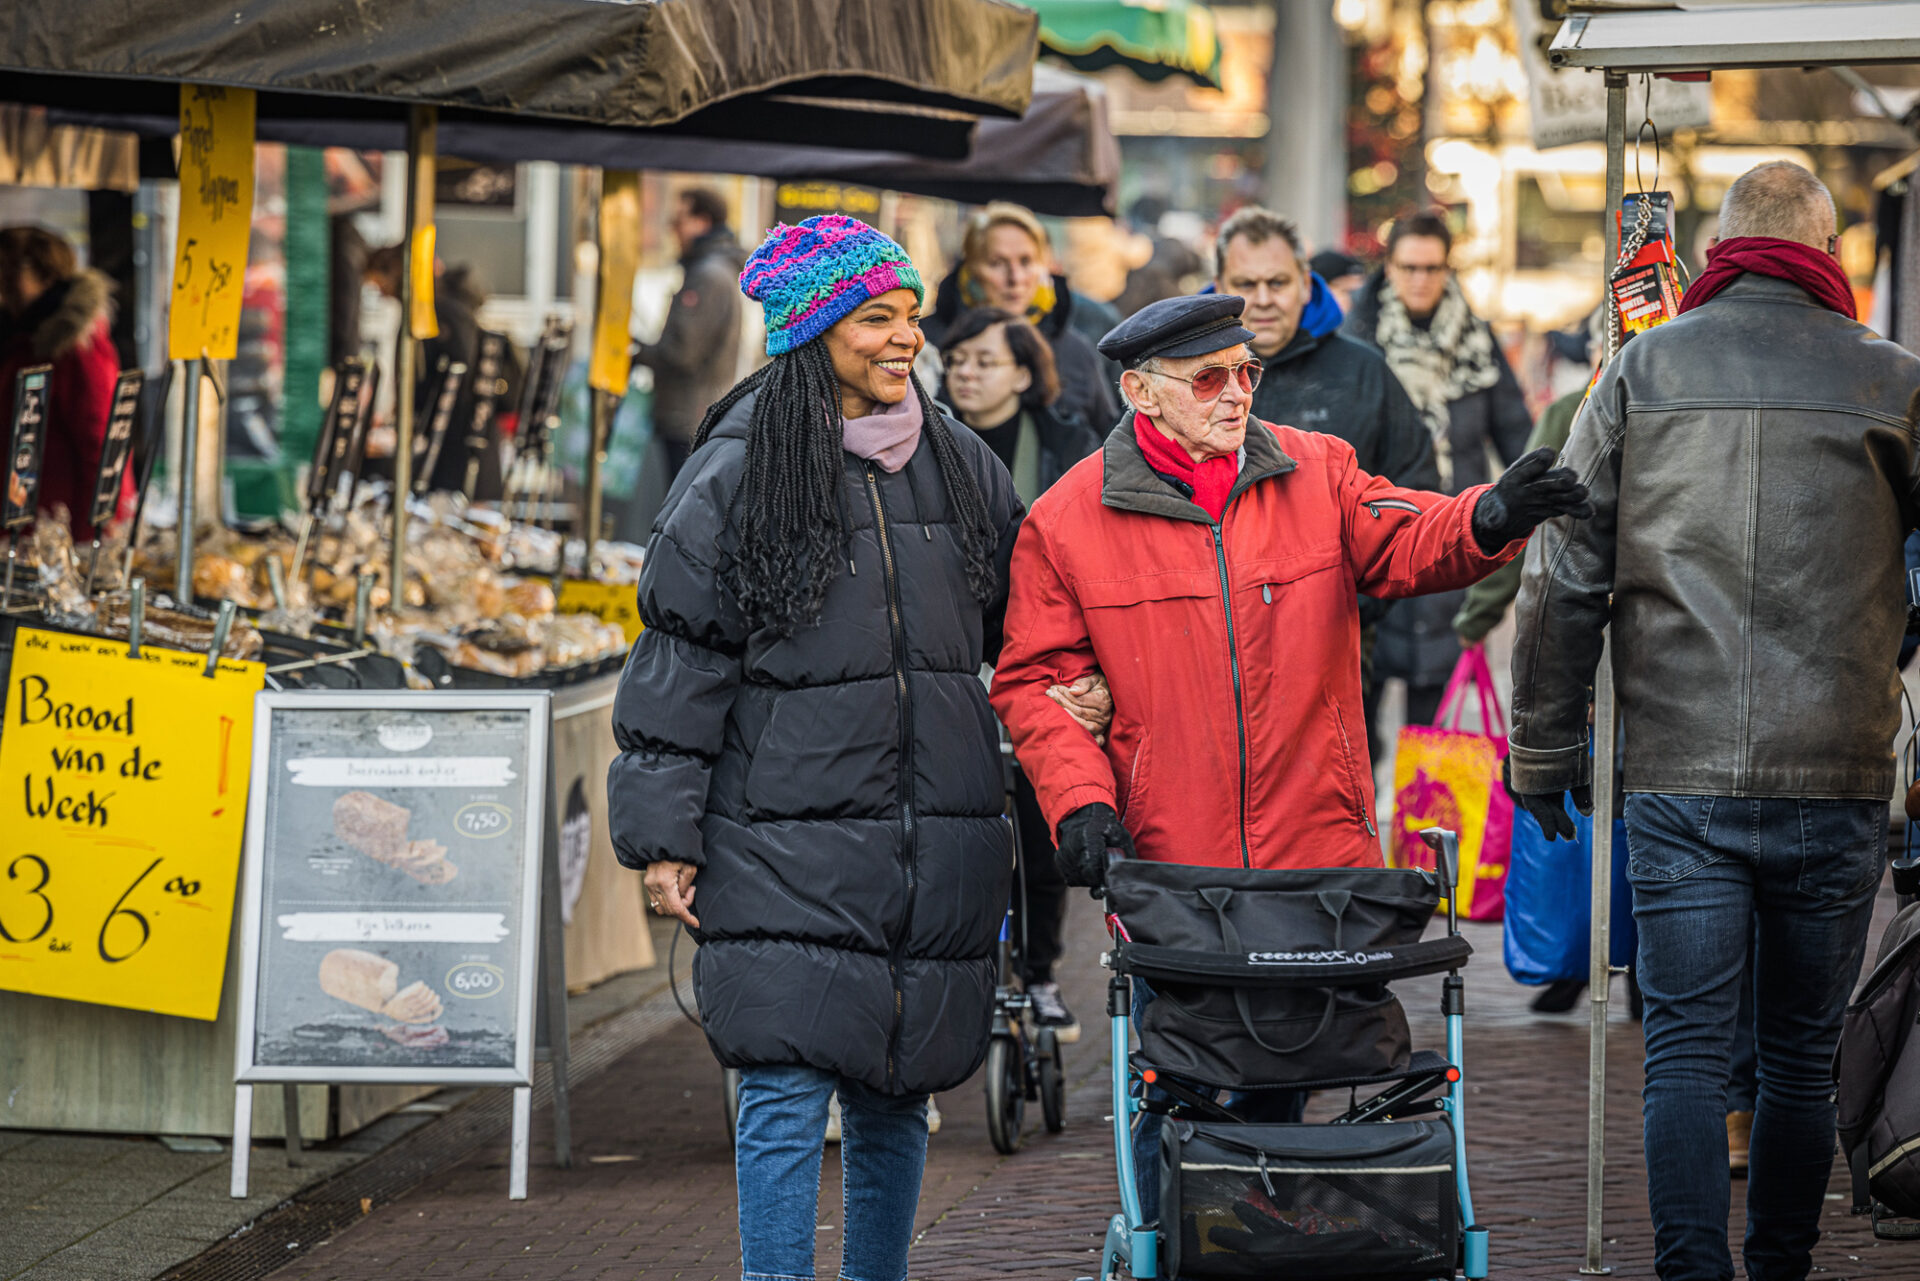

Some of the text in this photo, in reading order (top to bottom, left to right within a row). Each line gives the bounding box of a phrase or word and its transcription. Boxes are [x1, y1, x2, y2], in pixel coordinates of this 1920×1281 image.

[52, 745, 163, 781] van de
[25, 773, 116, 828] Week
[464, 812, 501, 831] 7,50
[0, 854, 54, 944] 3
[454, 972, 493, 990] 6,00
